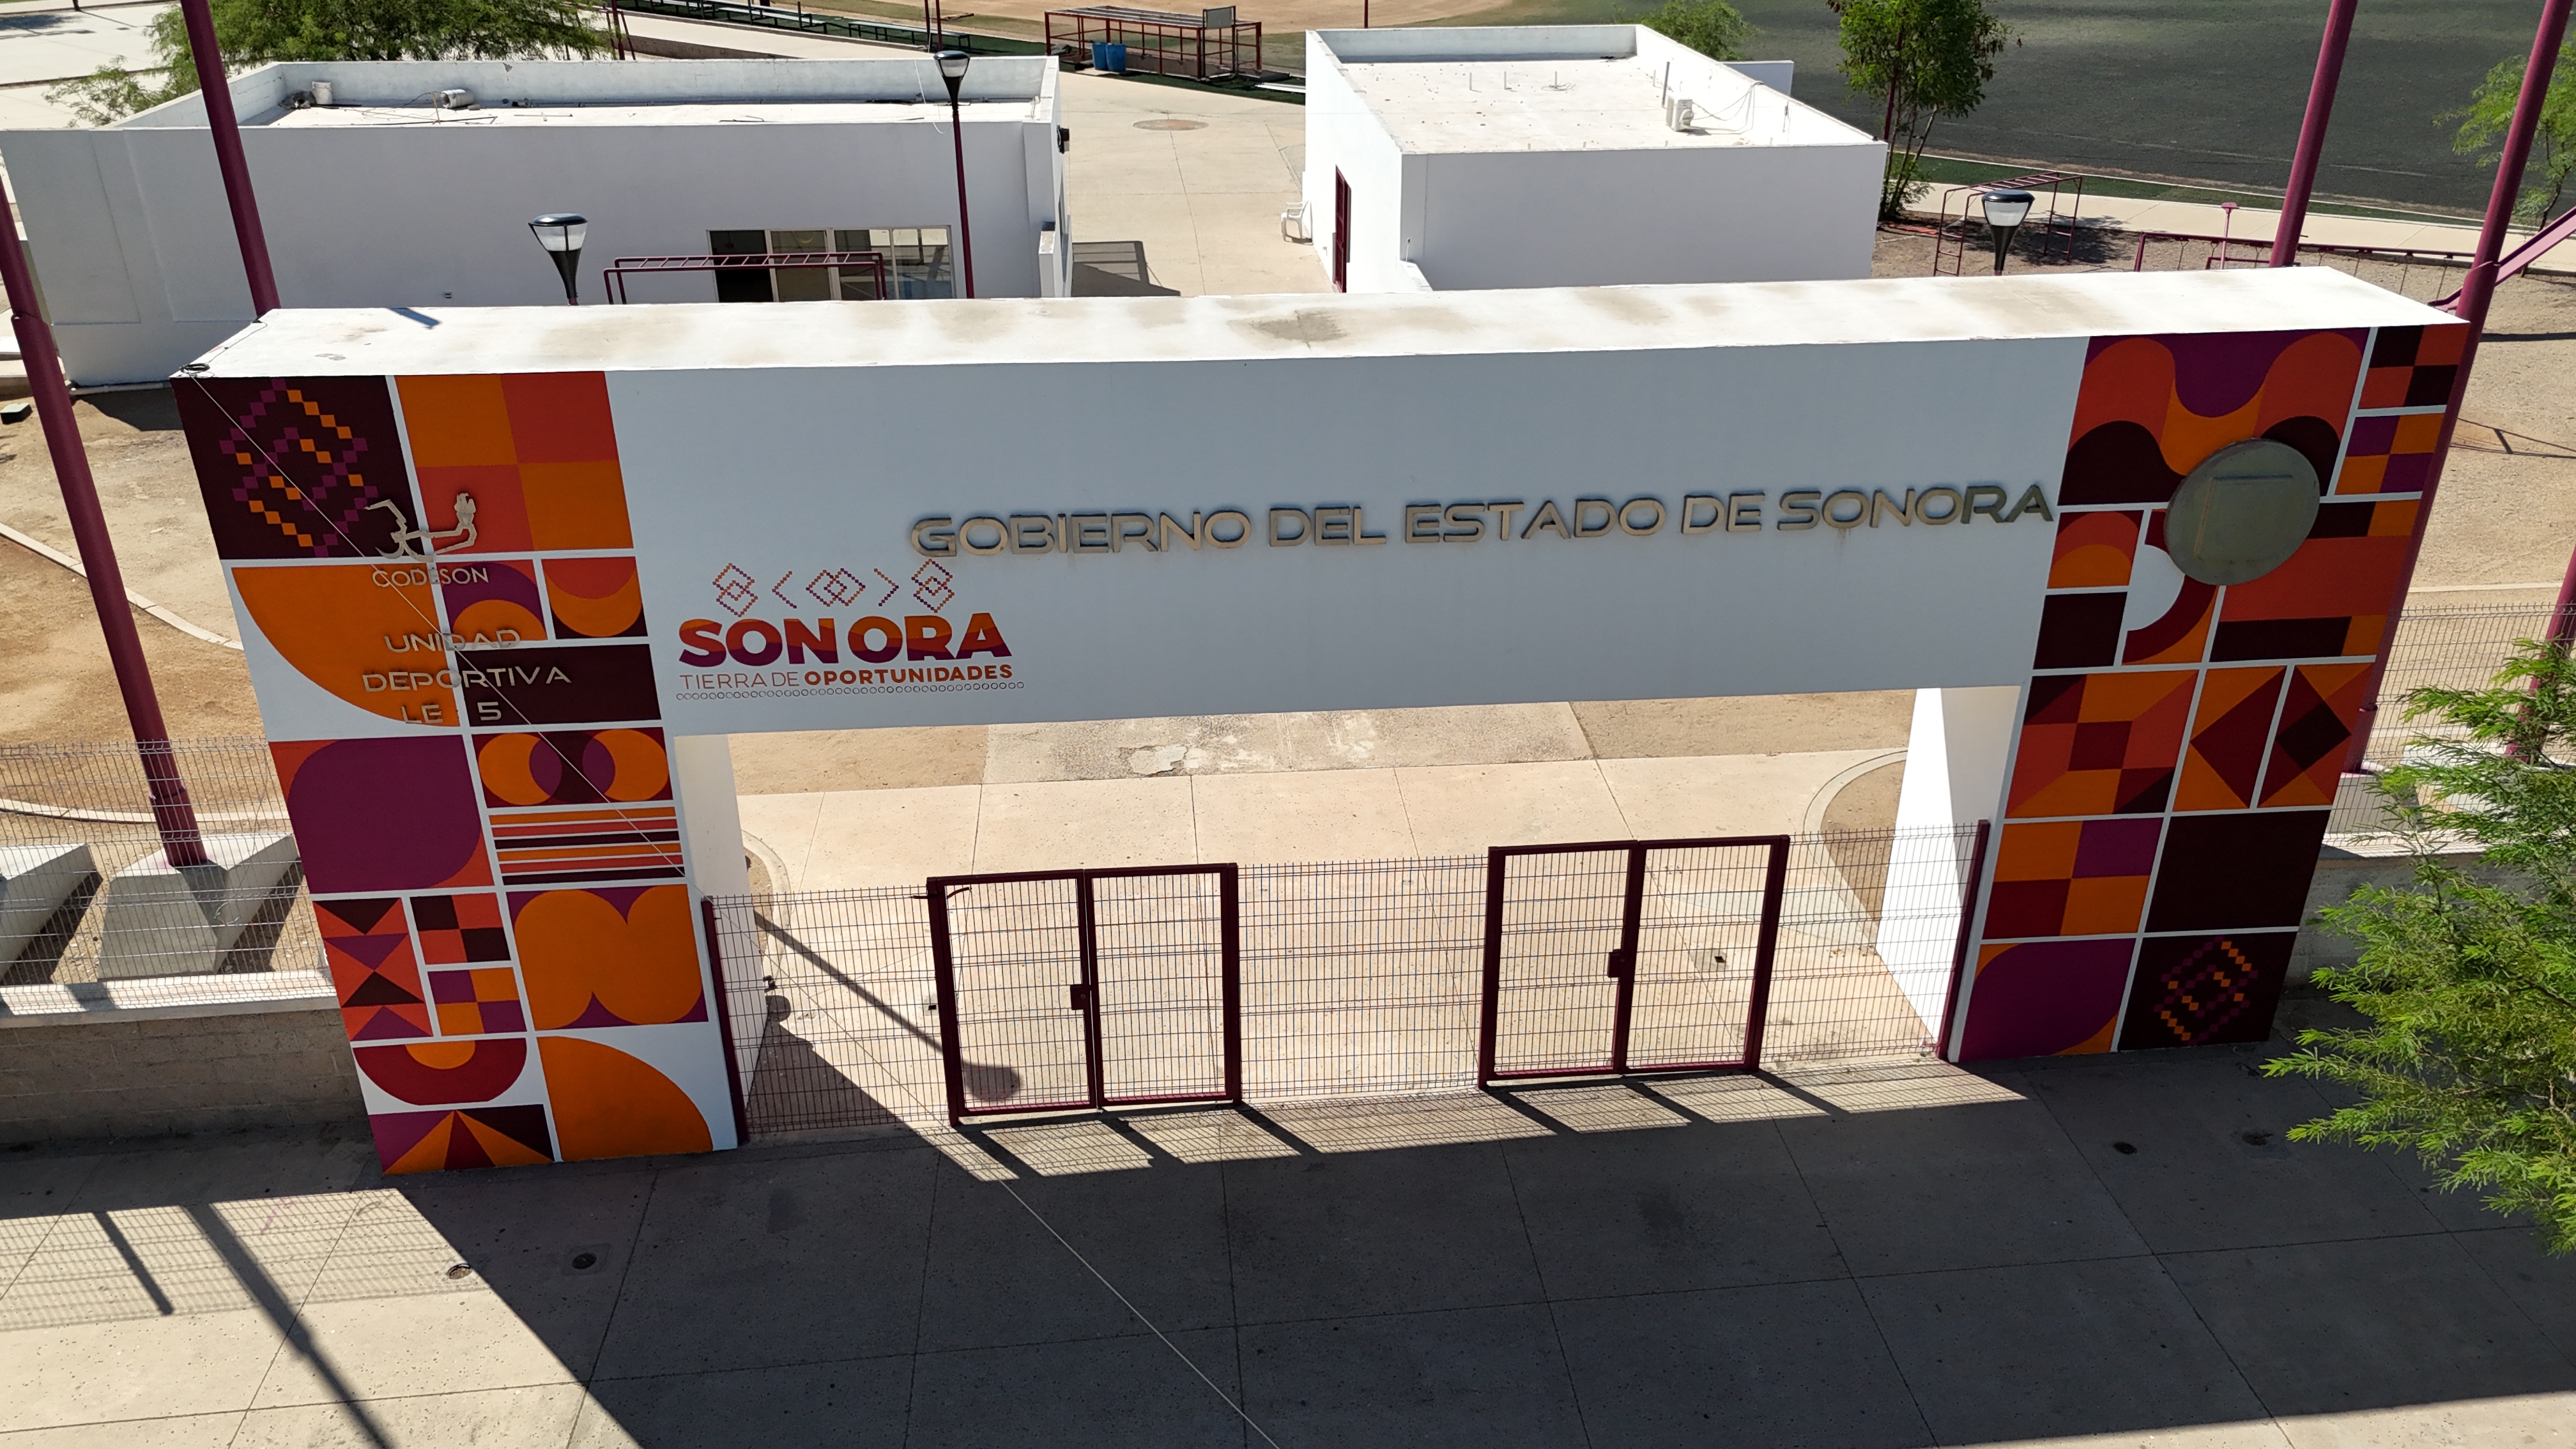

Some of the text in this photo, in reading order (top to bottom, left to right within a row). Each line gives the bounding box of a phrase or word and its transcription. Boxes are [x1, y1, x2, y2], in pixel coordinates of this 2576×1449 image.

[910, 484, 2053, 558] GOBIERNO DEL ESTADO DE SONORA
[384, 629, 521, 653] UNIDAD
[678, 613, 1013, 668] SONORA
[362, 666, 572, 693] DEPORTIVA
[679, 664, 1013, 690] TIERRA DE OPORTUNIDADES
